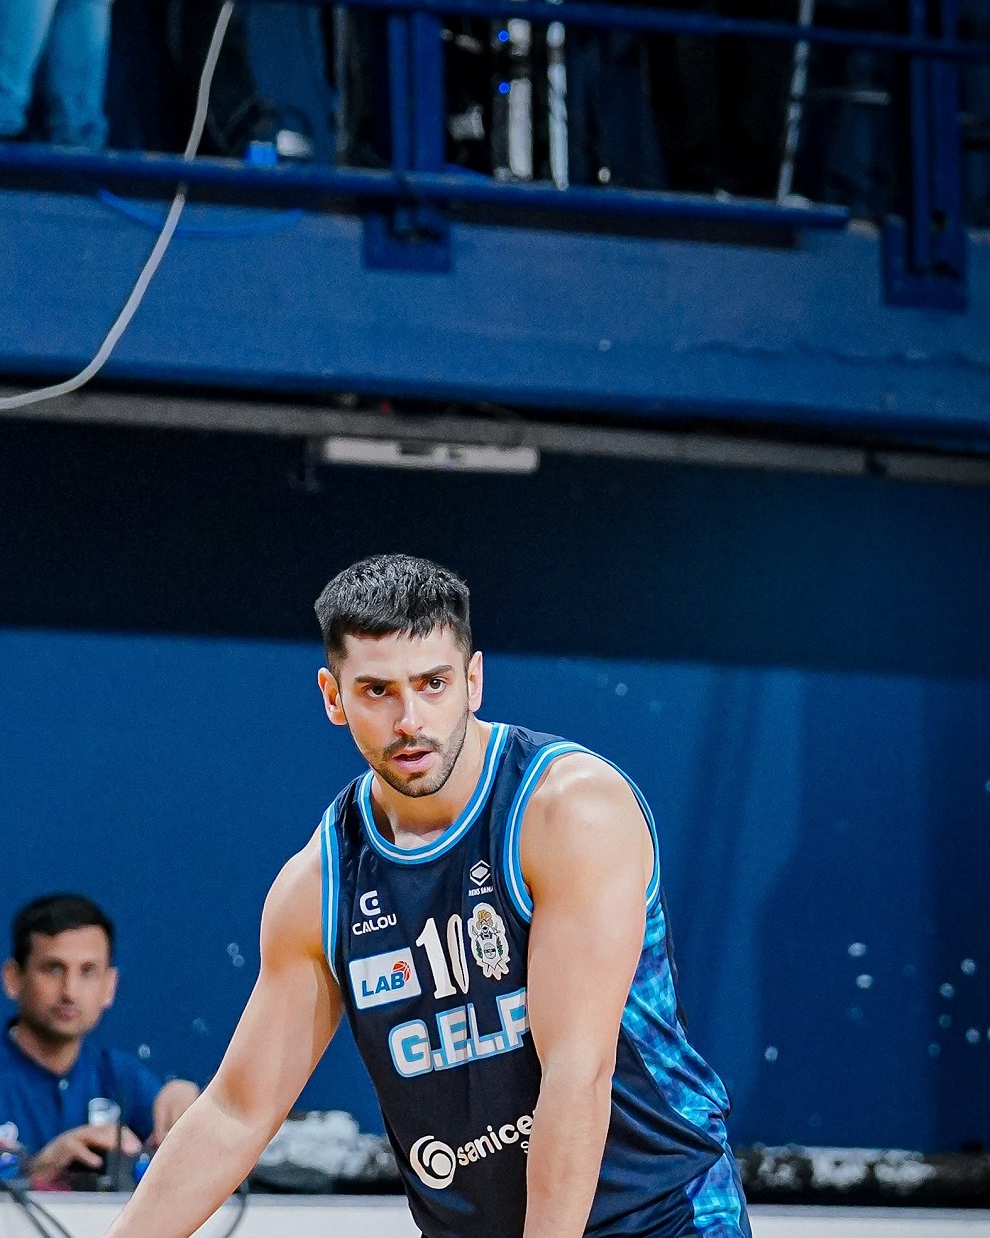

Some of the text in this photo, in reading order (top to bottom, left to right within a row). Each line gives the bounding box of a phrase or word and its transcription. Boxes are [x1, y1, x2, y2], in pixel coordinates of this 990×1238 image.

[352, 913, 397, 936] CALOU
[415, 913, 470, 1000] 10
[361, 971, 405, 998] LAB
[456, 1109, 535, 1167] sanice
